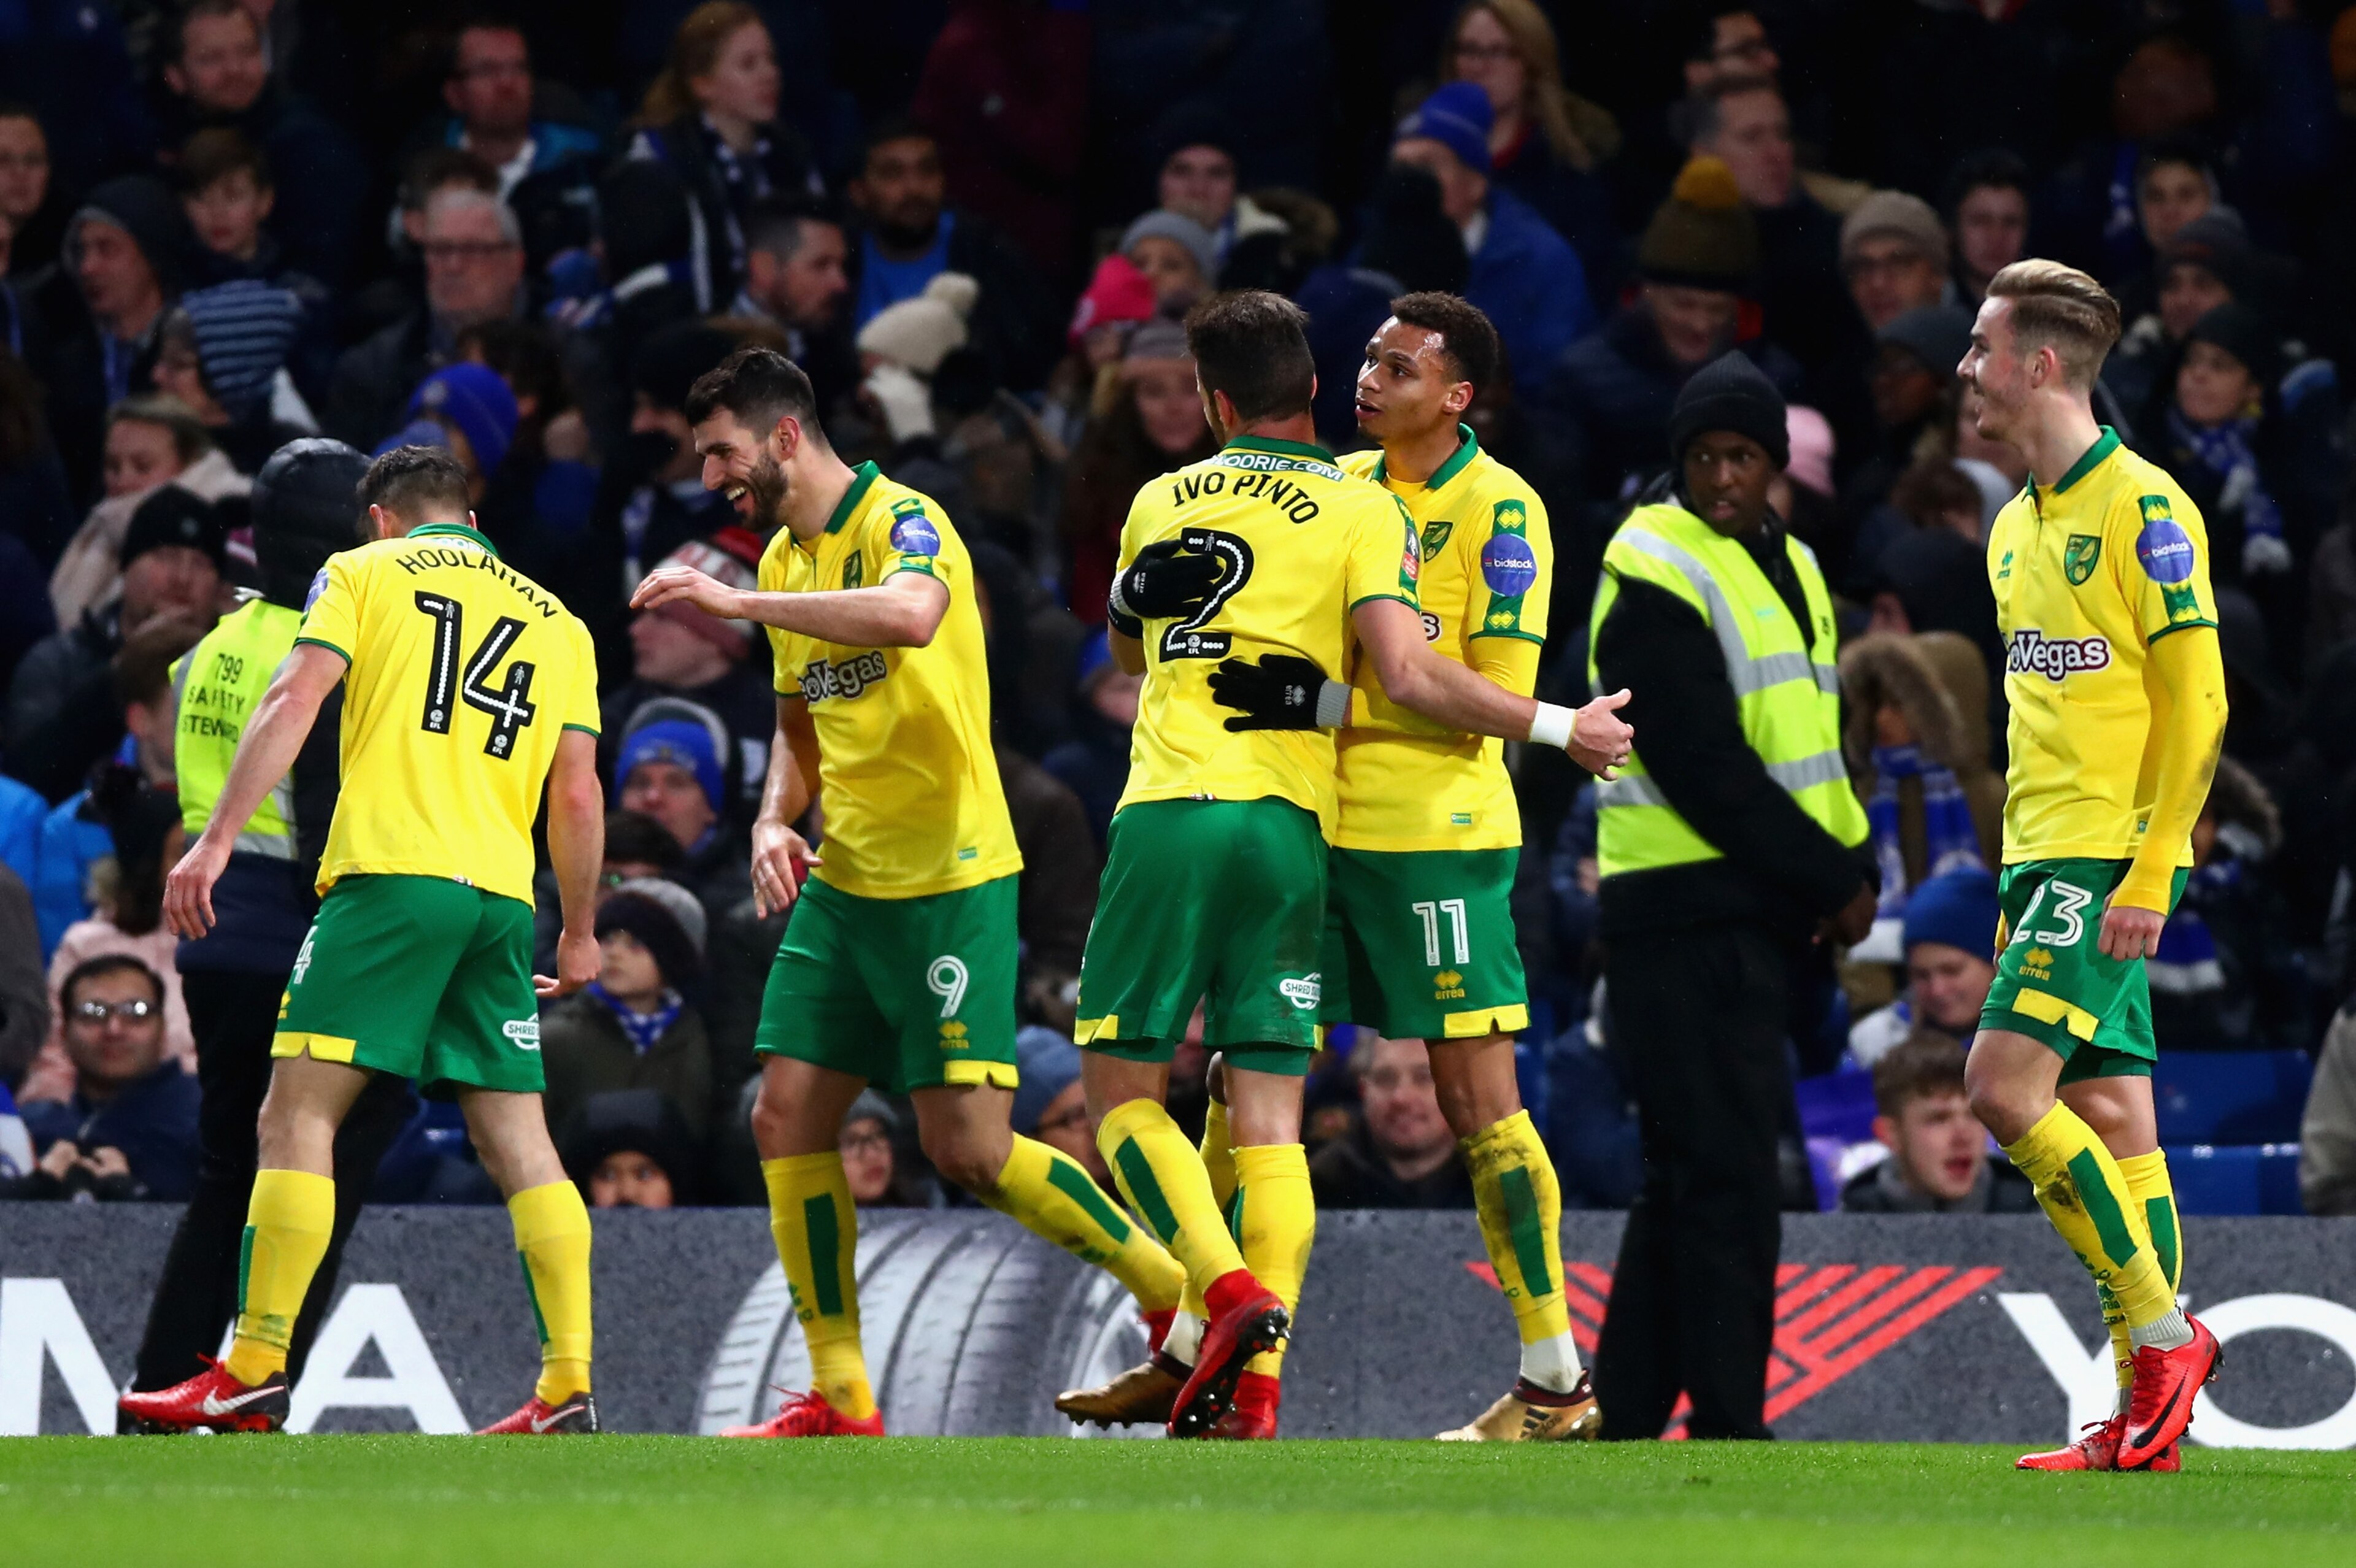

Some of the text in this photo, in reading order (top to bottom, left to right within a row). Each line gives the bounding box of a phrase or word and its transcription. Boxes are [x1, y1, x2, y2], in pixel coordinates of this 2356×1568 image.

[1172, 472, 1319, 524] IVO PINTO
[395, 548, 558, 618] HOOLAHAN
[1494, 557, 1533, 569] bidstock
[1159, 528, 1254, 663] 2
[215, 653, 244, 685] 799
[415, 590, 537, 761] 14
[799, 650, 887, 701] oVegas
[2008, 630, 2109, 682] oVegas
[1412, 898, 1470, 966] 11
[2011, 880, 2093, 947] 23
[926, 955, 969, 1018] 9
[1285, 983, 1311, 994] SHRED
[1435, 988, 1465, 1001] errea
[2019, 965, 2050, 982] errea
